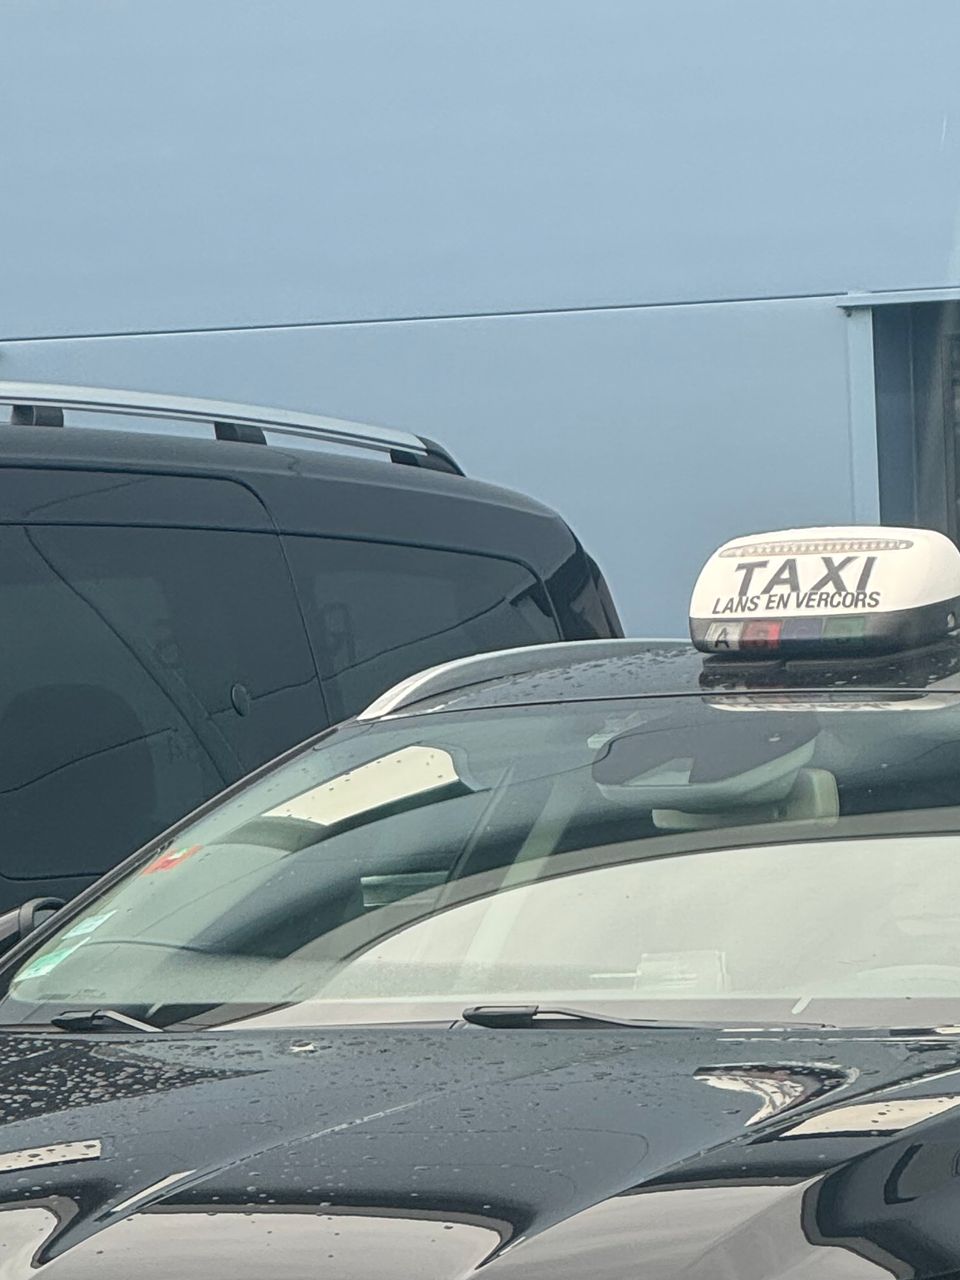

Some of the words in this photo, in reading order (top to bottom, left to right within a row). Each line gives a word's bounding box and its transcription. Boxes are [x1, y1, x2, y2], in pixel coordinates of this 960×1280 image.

[735, 556, 878, 597] TAXI
[712, 594, 761, 614] LANS
[765, 592, 792, 610] EN
[795, 591, 881, 609] VERCORS
[714, 627, 730, 648] A
